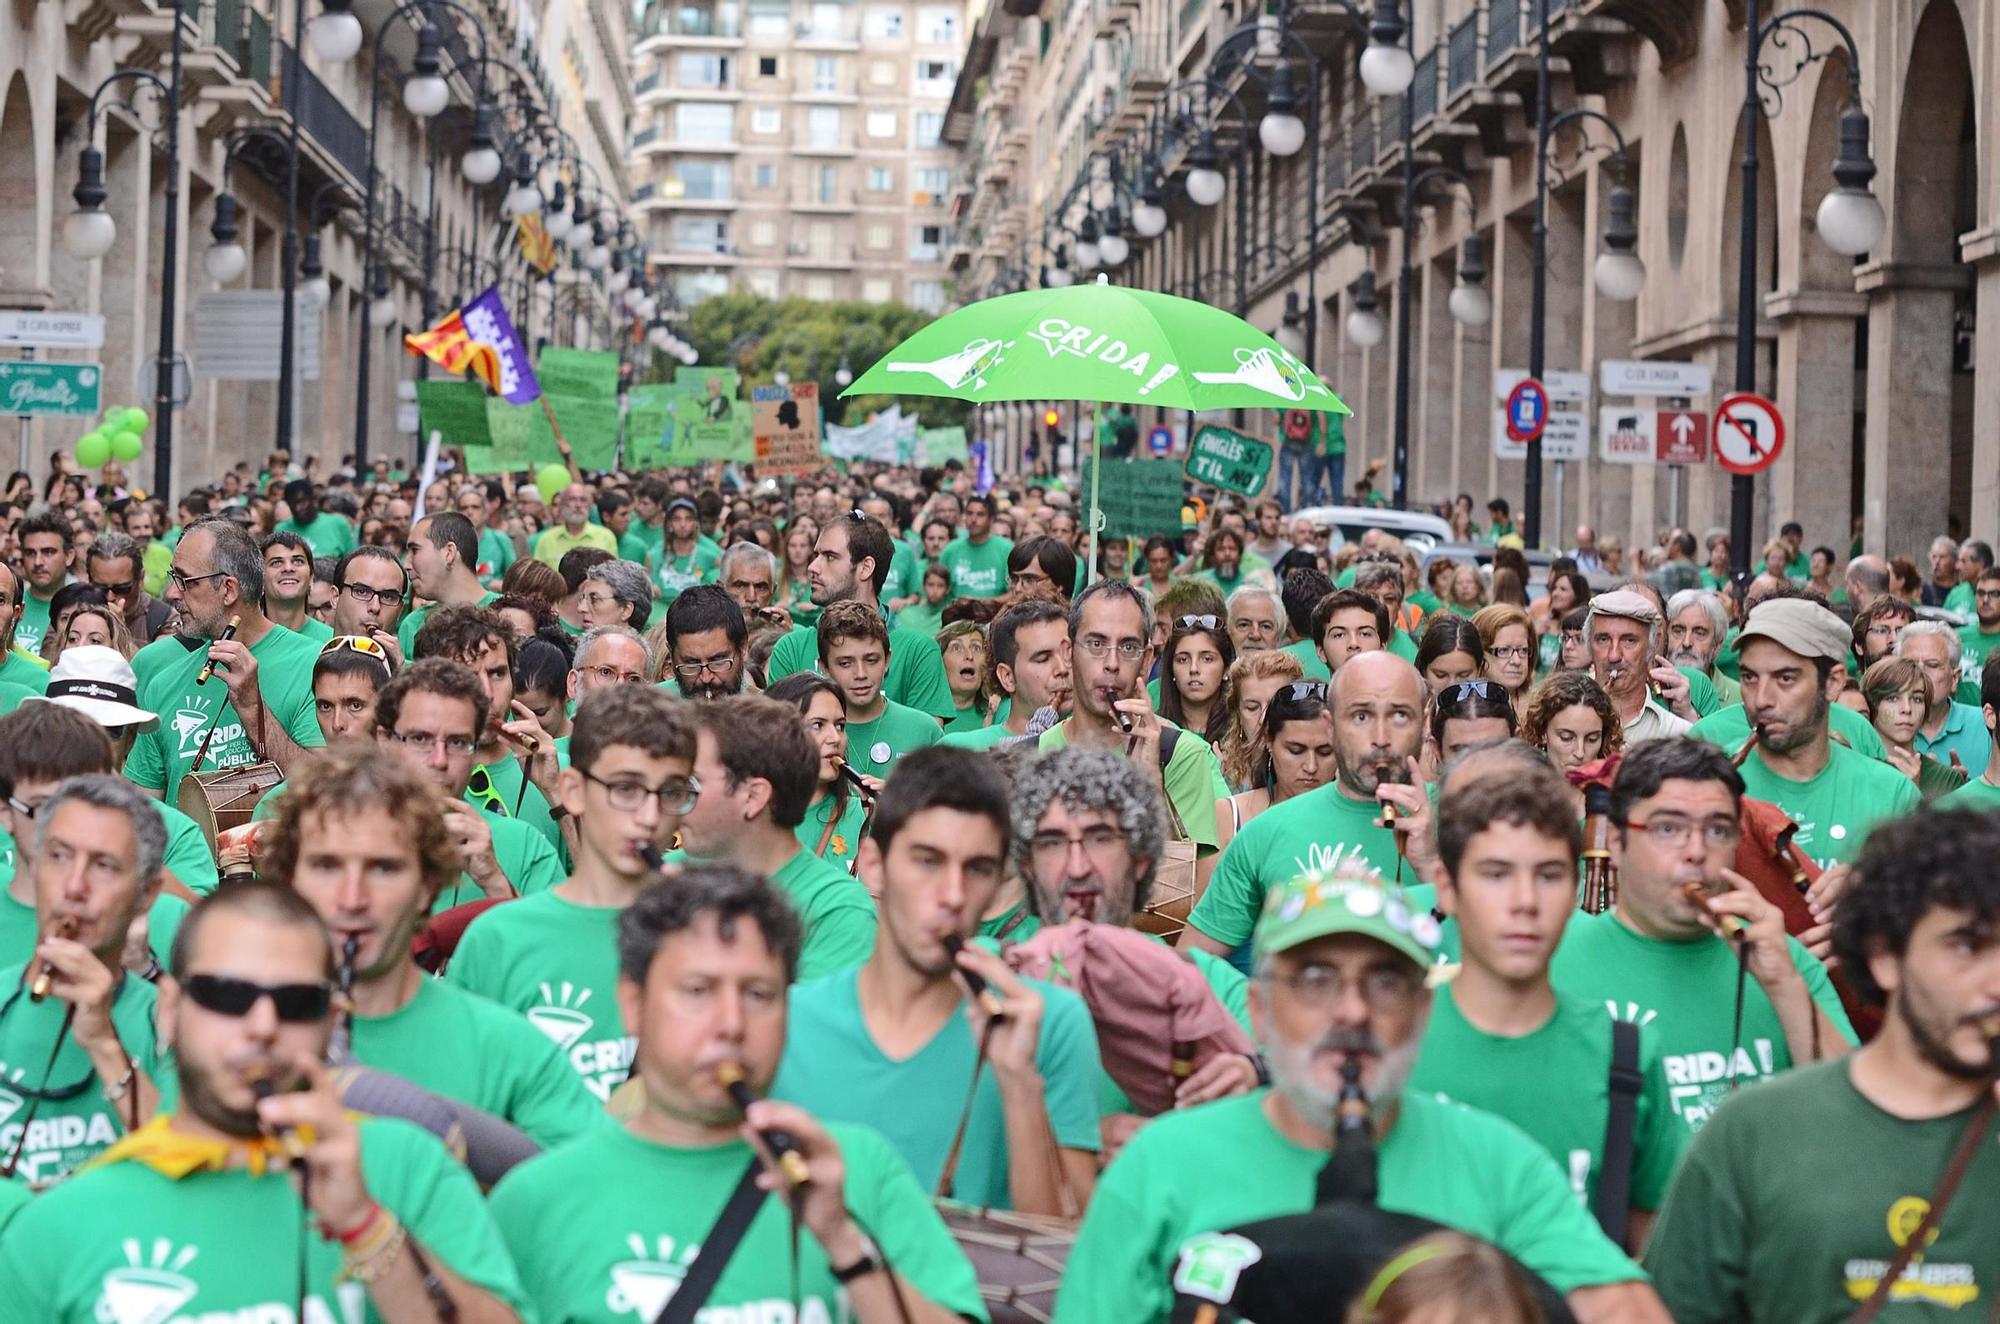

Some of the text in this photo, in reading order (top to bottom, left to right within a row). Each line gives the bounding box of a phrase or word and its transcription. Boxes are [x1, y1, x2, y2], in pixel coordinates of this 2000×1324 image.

[1039, 319, 1180, 396] CRIDA!
[1198, 432, 1245, 462] ANGLÈS
[1196, 456, 1224, 482] TIL
[217, 751, 261, 770] PÚBLIC
[569, 1036, 640, 1073] CRI
[1662, 1038, 1773, 1086] RIDA!
